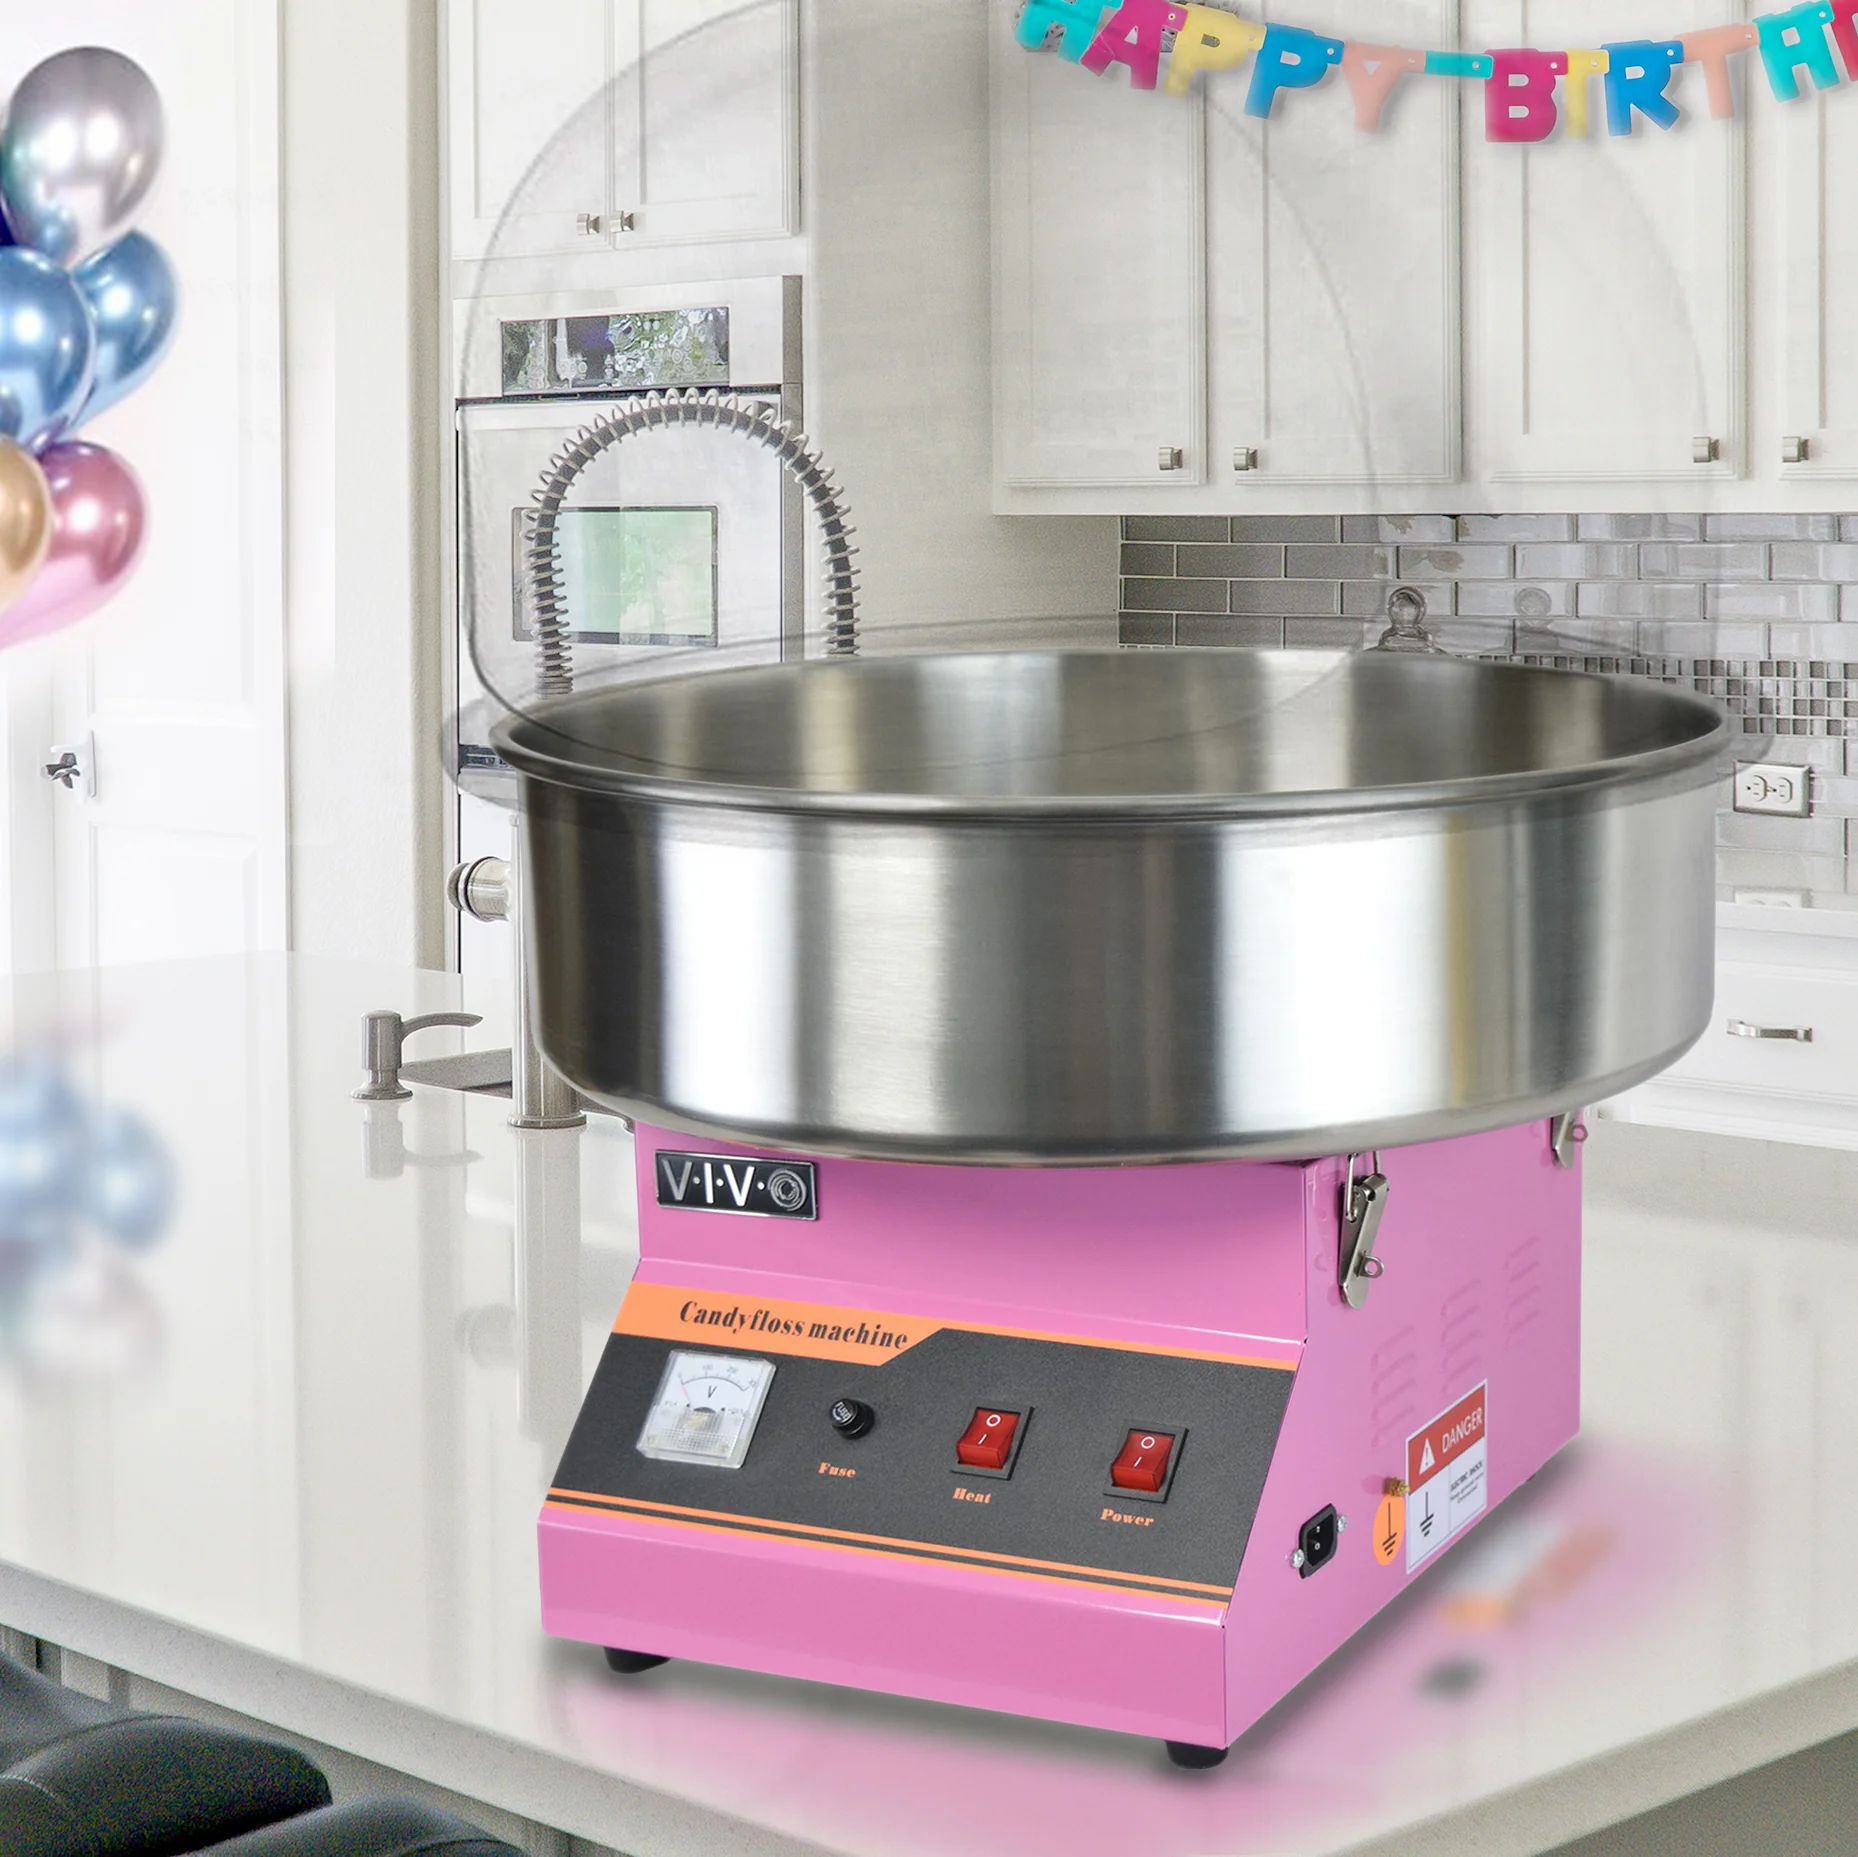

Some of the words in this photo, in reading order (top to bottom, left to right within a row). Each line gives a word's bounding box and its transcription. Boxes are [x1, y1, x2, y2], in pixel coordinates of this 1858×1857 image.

[1014, 0, 1420, 132] HAPPY
[680, 1300, 804, 1335] Candyfloss
[808, 1319, 908, 1350] machine
[1441, 1406, 1483, 1454] DANGER
[818, 1461, 857, 1480] Fuse
[952, 1487, 992, 1505] Heat
[1100, 1508, 1155, 1528] Power
